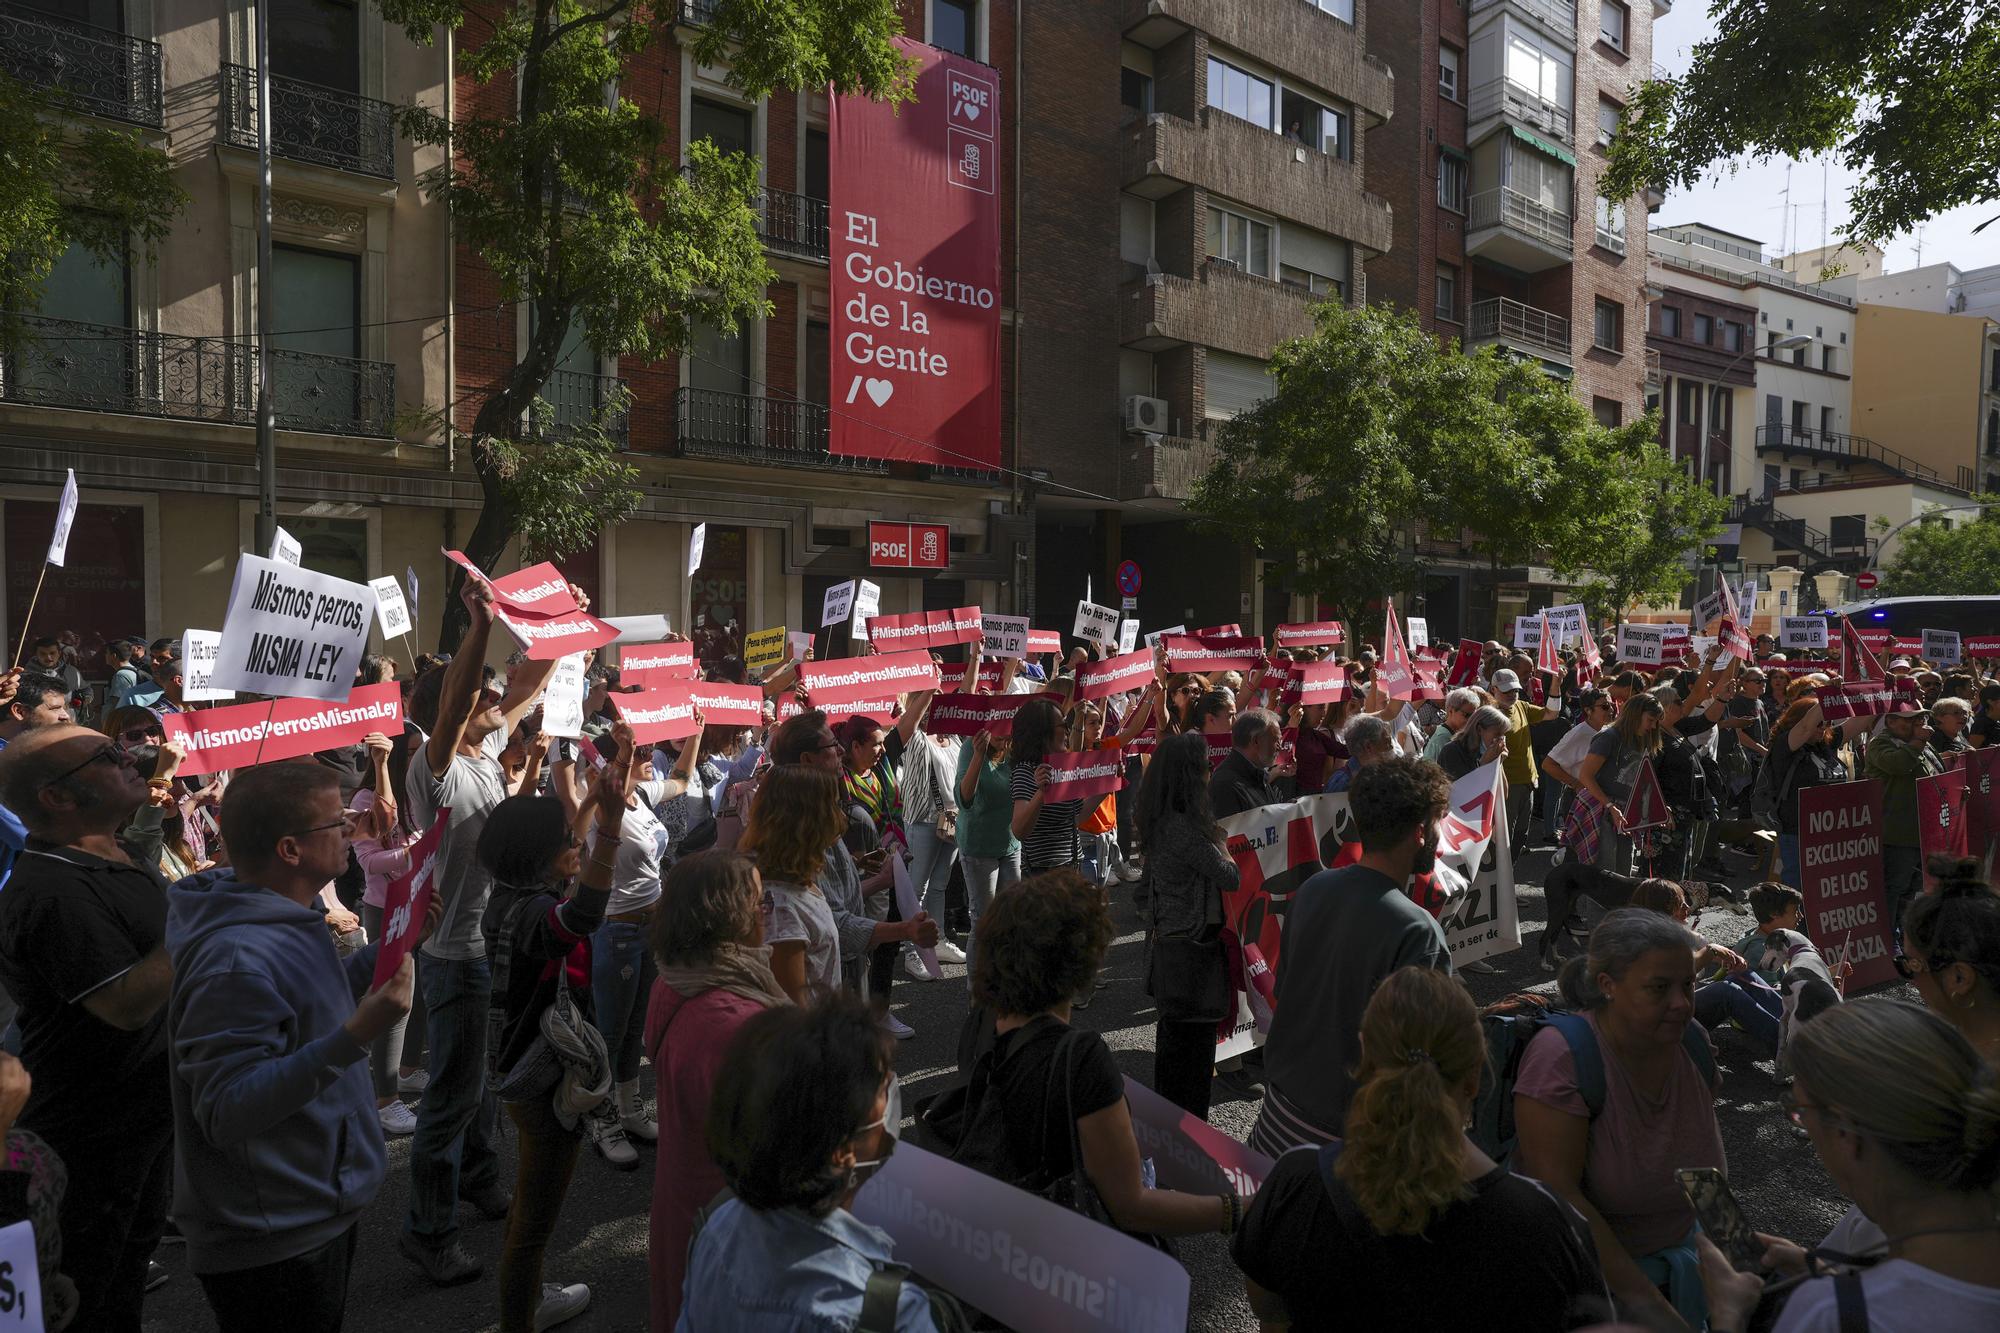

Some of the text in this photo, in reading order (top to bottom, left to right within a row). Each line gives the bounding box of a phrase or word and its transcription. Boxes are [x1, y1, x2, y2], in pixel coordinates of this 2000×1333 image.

[953, 80, 988, 109] PSOE
[845, 211, 879, 248] El
[845, 252, 994, 310] Gobierno
[845, 292, 930, 335] de la
[845, 331, 949, 377] Gente
[871, 542, 907, 559] PSOE
[251, 569, 364, 637] Mismos perros,
[1081, 604, 1092, 616] No
[871, 618, 982, 639] #MismosPerrosMismaLey
[1004, 621, 1027, 636] perros,
[1082, 625, 1103, 639] sufri
[1521, 619, 1541, 630] Mismos
[1623, 628, 1642, 640] Mismos
[1785, 618, 1806, 629] Mismos
[1005, 638, 1020, 652] LEY.
[1790, 632, 1808, 642] MISMA
[245, 632, 344, 683] MISMA LEY.
[1167, 646, 1264, 660] #MismosPerrosMismaLey
[1625, 645, 1642, 657] MISMA
[622, 653, 694, 672] #MismosPerrosMismaLey
[804, 663, 935, 690] #MismosPerrosMismaLey
[688, 693, 761, 714] PerrosMismaLey
[173, 700, 398, 751] #MismosPerrosMismaLey
[1808, 804, 1872, 835] NO A LA
[1805, 833, 1880, 867] EXCLUSIÓN
[1820, 870, 1869, 899] DE LOS
[1819, 900, 1878, 935] PERROS
[1459, 941, 1466, 950] a
[1467, 933, 1483, 947] ser
